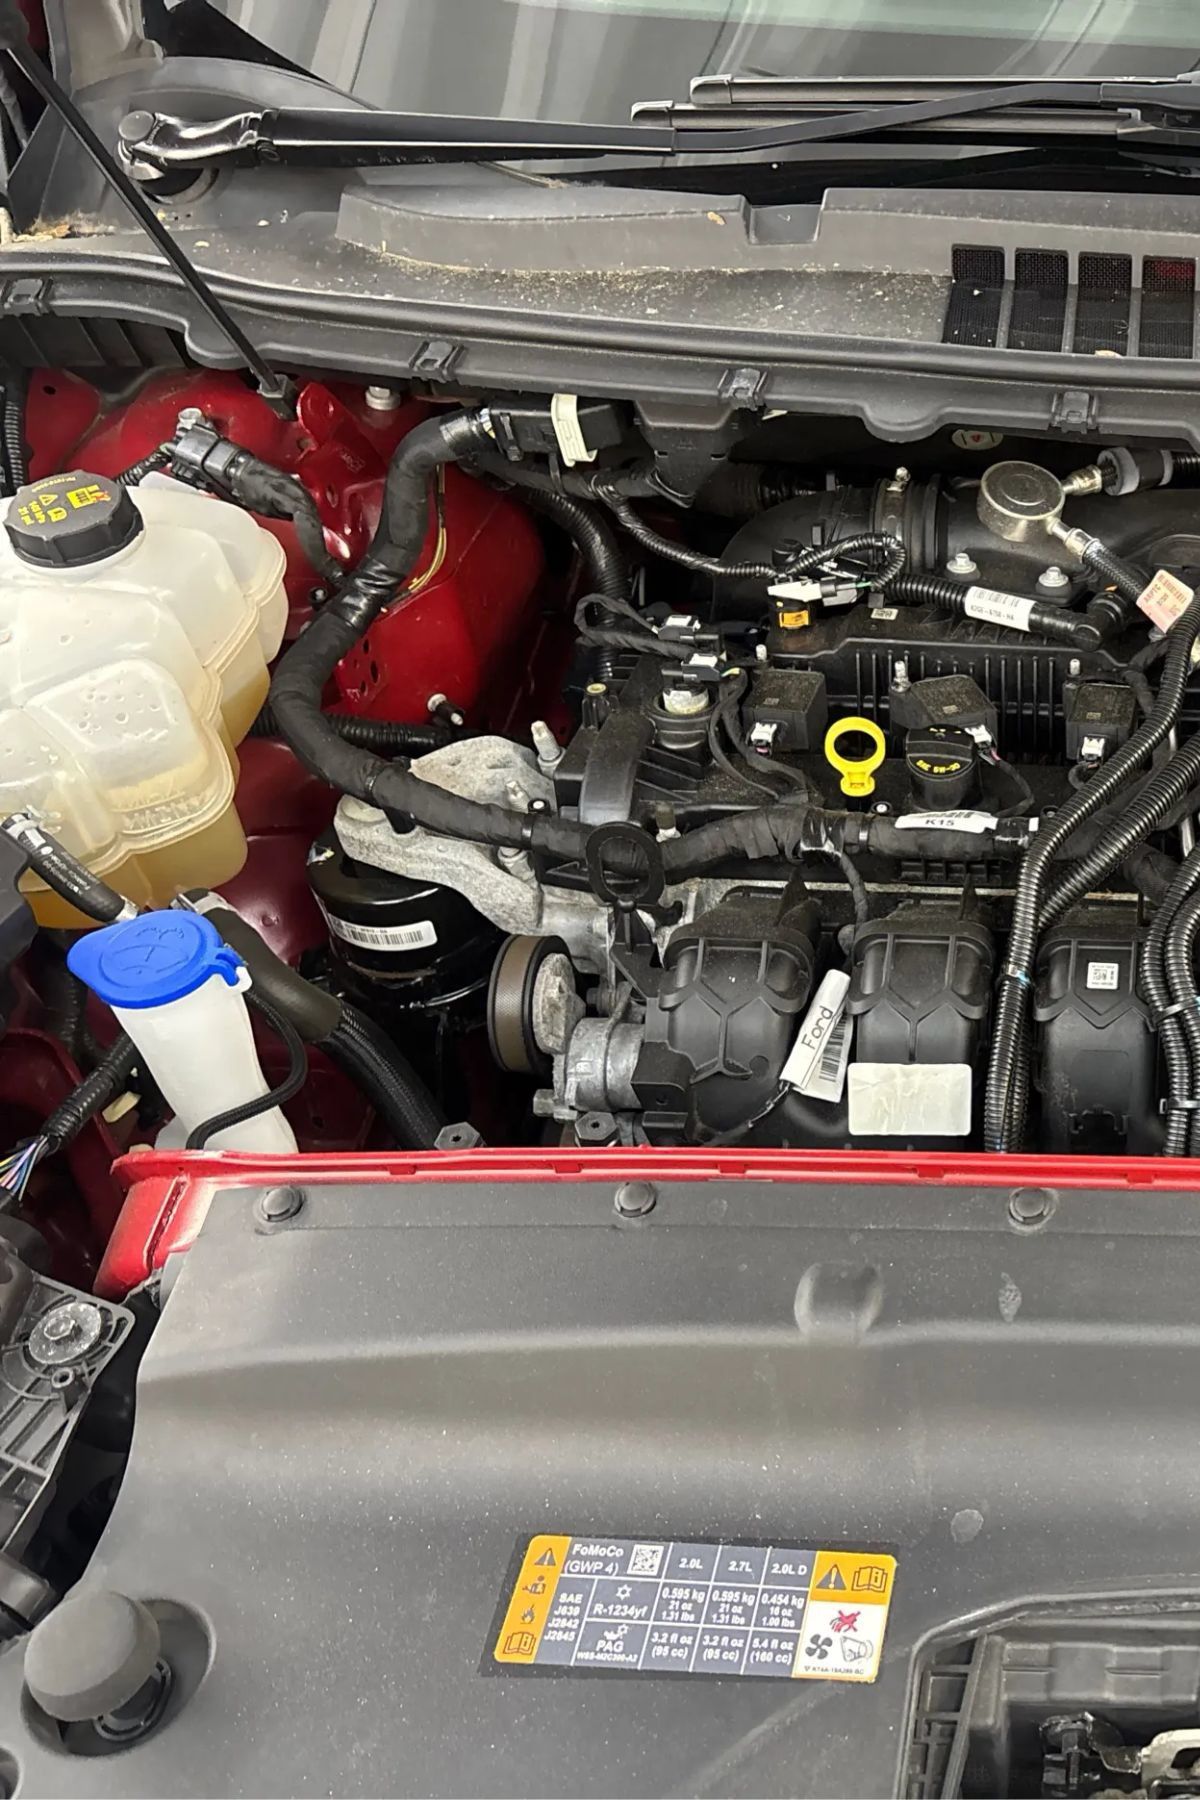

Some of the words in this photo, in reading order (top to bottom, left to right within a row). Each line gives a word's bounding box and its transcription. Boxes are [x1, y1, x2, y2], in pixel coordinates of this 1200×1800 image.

[925, 819, 955, 827] K15
[801, 1005, 834, 1051] Ford
[572, 1543, 624, 1557] FoMoCo
[564, 1559, 603, 1574] (GWP
[604, 1562, 619, 1577] 4)
[679, 1558, 703, 1570] 2.0L
[728, 1560, 752, 1572] 2.7L
[771, 1563, 795, 1575] 2.0L
[798, 1565, 807, 1575] D
[559, 1592, 583, 1604] SAE
[662, 1587, 690, 1600] 0.595
[692, 1589, 706, 1603] kg
[712, 1590, 740, 1602] 0.595
[742, 1592, 756, 1606] kg
[761, 1593, 789, 1605] 0.454
[791, 1595, 805, 1609] kg
[593, 1603, 648, 1620] R-1234yf
[668, 1600, 680, 1611] 21
[681, 1603, 693, 1611] oz
[718, 1603, 730, 1613] 21
[731, 1606, 743, 1614] oz
[662, 1611, 679, 1621] 1.31
[681, 1611, 695, 1622] lbs
[712, 1613, 729, 1624] 1.31
[731, 1614, 745, 1625] lbs
[781, 1608, 793, 1617] oz
[781, 1617, 795, 1628] lbs
[651, 1632, 668, 1643] 3.2
[680, 1636, 693, 1645] oz
[702, 1635, 720, 1646] 3.2
[731, 1638, 744, 1647] oz
[752, 1637, 769, 1649] 5.4
[780, 1641, 794, 1650] oz
[596, 1640, 624, 1653] PAG
[652, 1646, 670, 1659] (95
[671, 1647, 688, 1660] cc)
[703, 1649, 720, 1661] (95
[721, 1650, 739, 1662] cc)
[750, 1651, 773, 1664] (160
[775, 1653, 793, 1666] cc)
